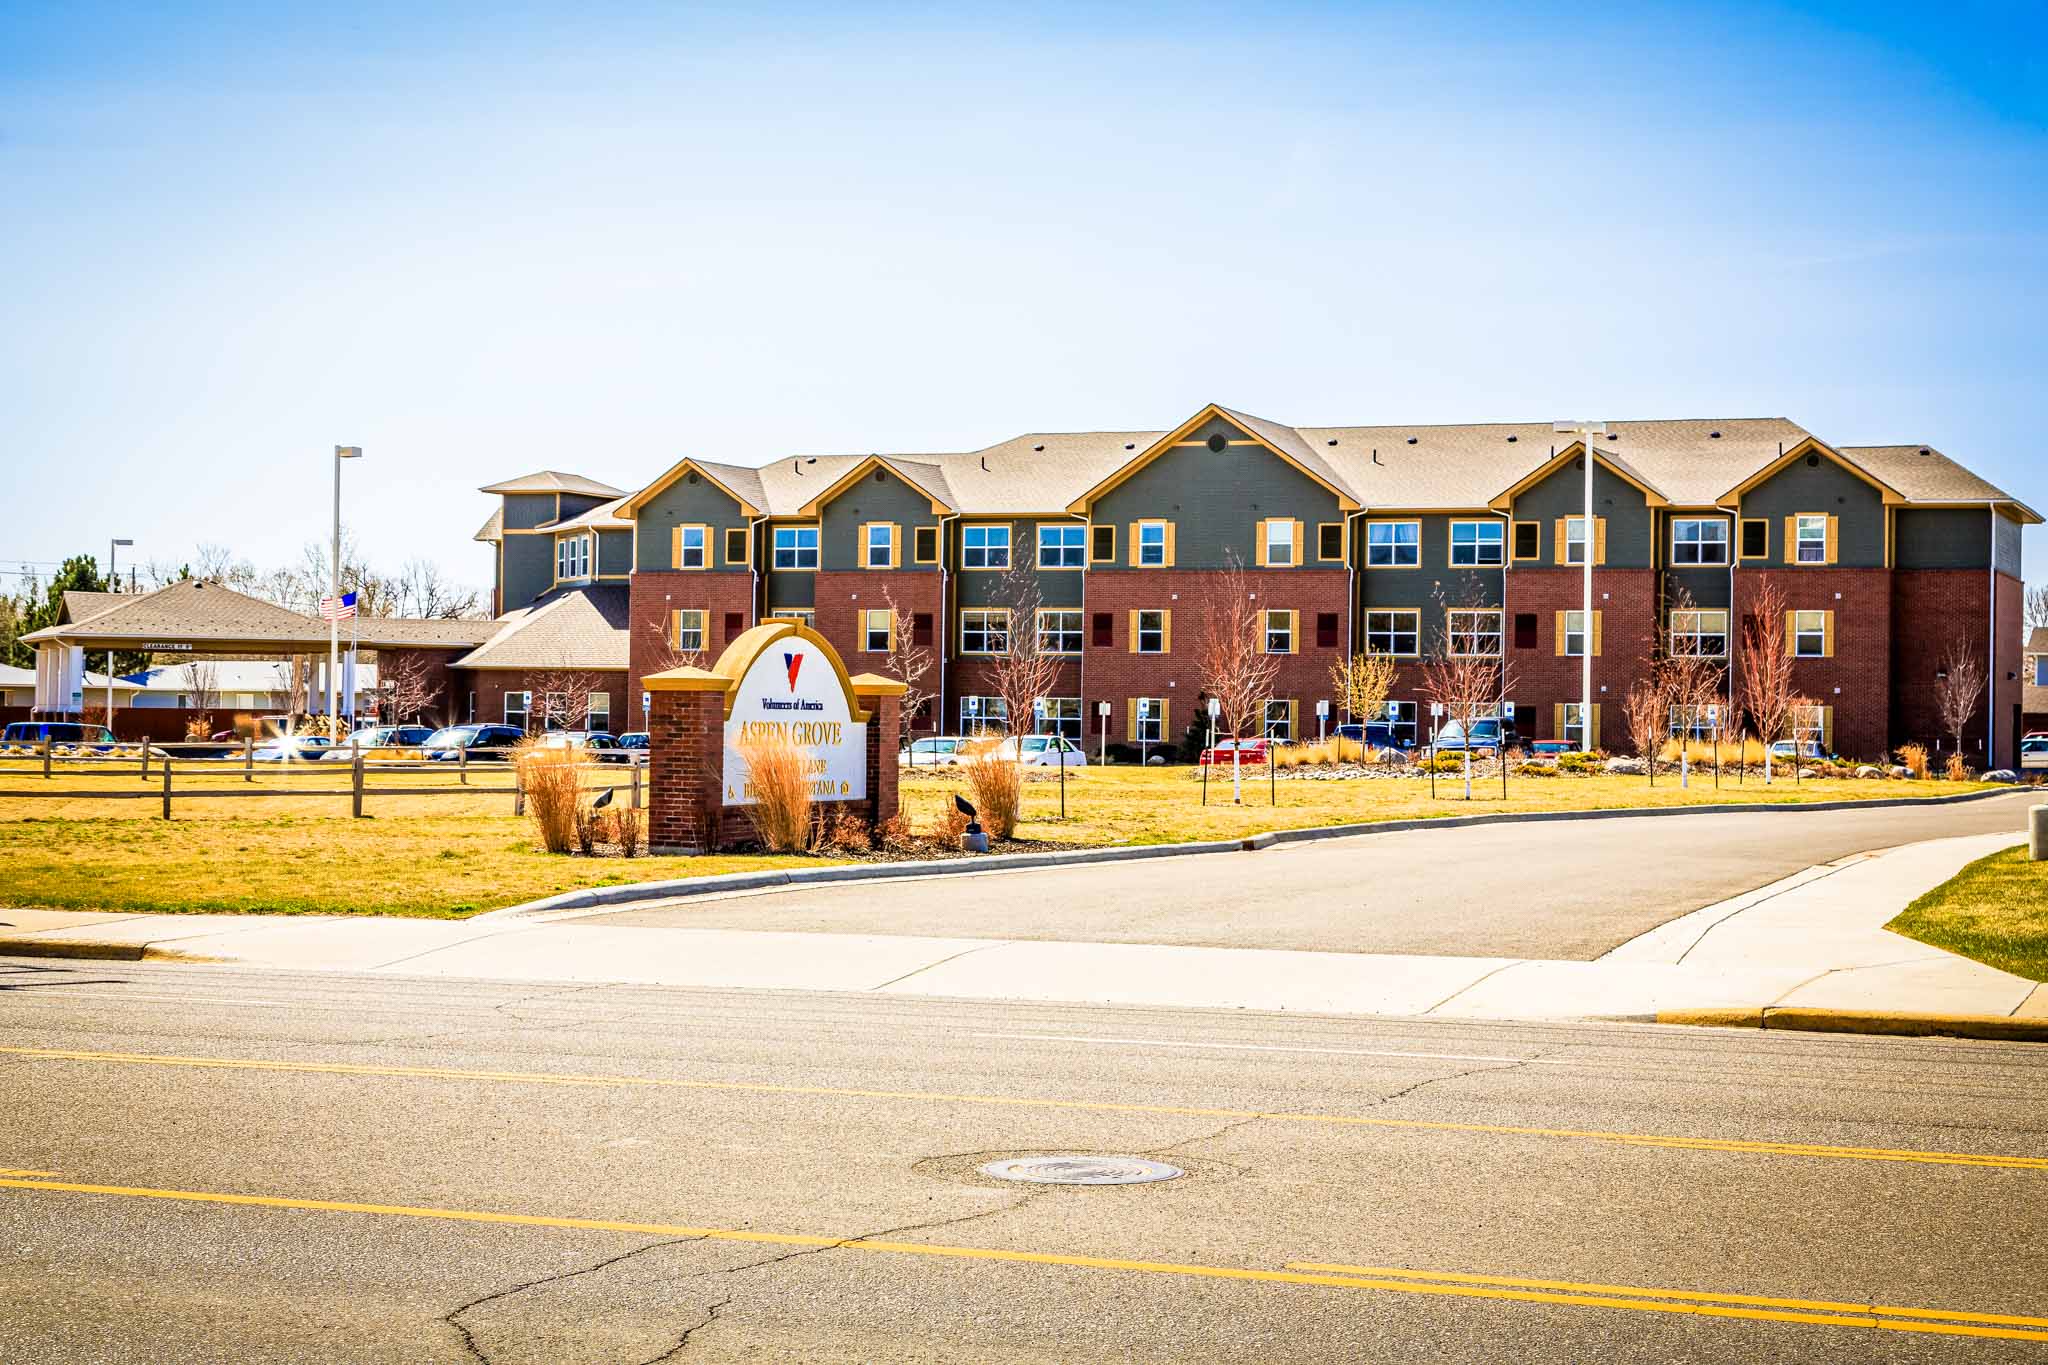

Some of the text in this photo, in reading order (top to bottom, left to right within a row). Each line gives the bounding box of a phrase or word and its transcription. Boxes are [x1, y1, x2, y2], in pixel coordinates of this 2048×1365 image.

[793, 698, 800, 710] of
[739, 720, 841, 745] ASPEN GROVE
